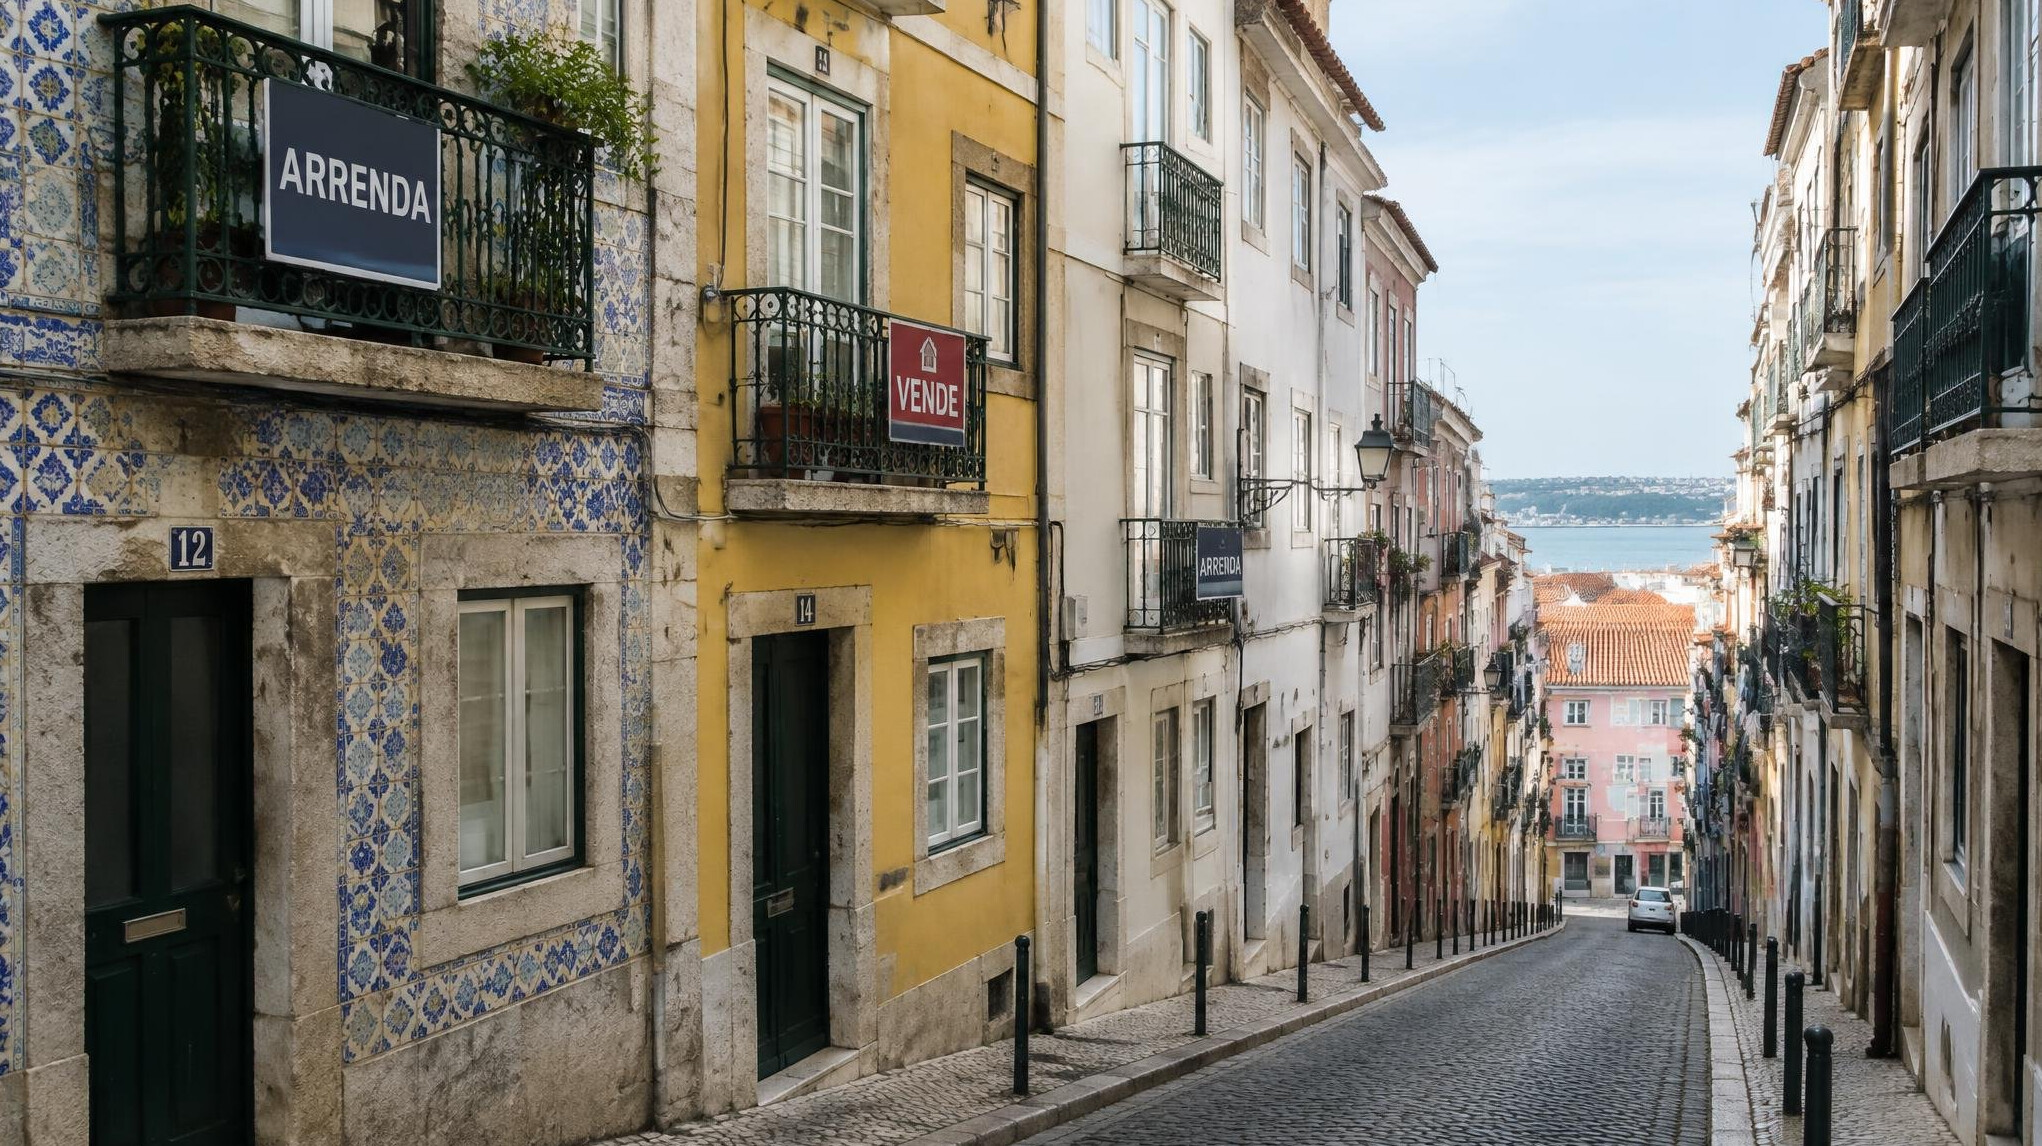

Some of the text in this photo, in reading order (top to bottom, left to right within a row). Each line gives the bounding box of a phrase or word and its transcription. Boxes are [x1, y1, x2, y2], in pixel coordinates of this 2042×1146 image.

[279, 147, 431, 224] ARRENDA
[896, 375, 959, 418] VENDE
[178, 529, 206, 567] 12
[1199, 555, 1242, 577] ARRENDA
[800, 597, 813, 622] 14
